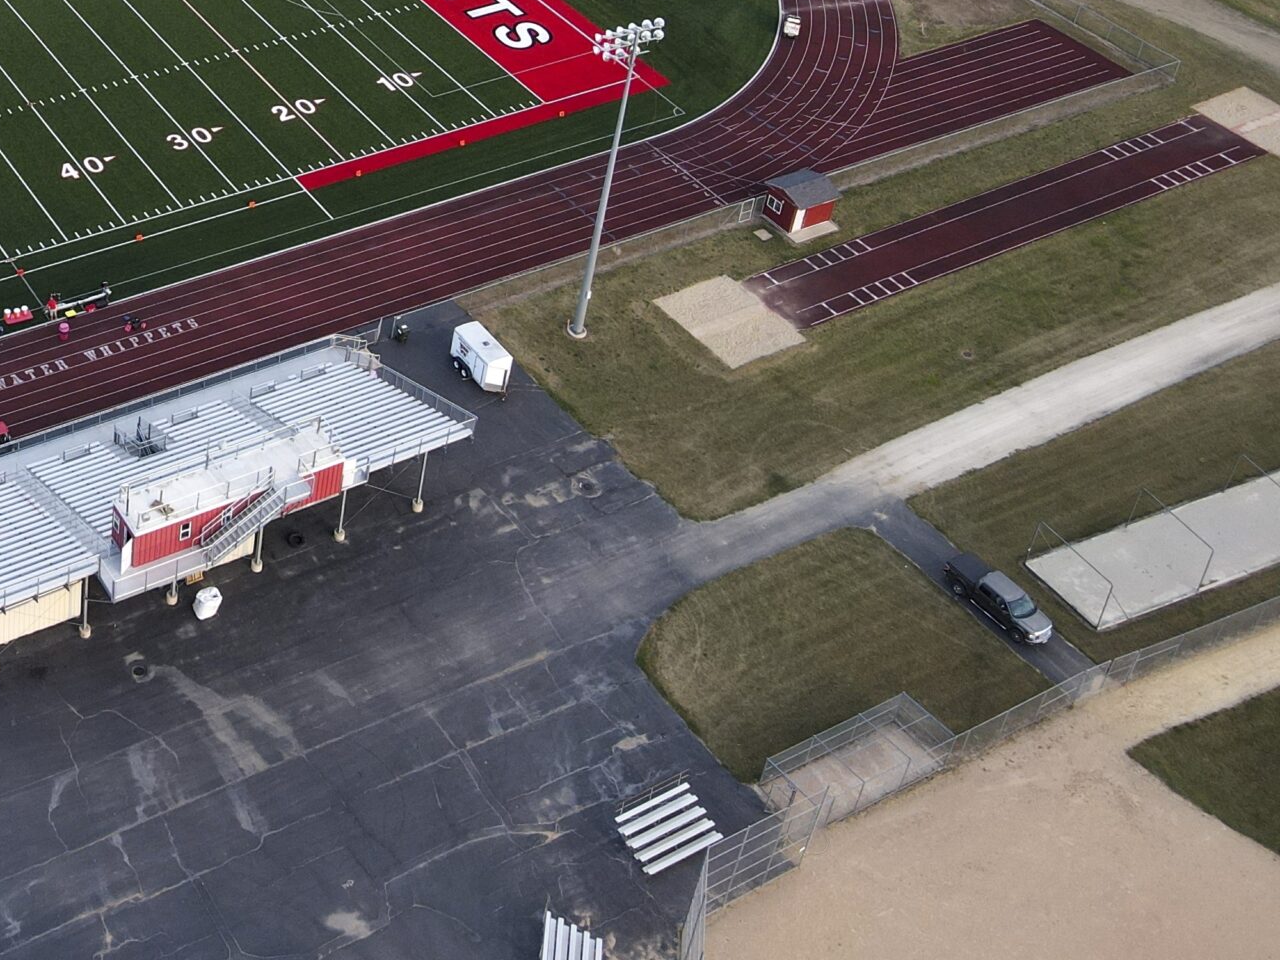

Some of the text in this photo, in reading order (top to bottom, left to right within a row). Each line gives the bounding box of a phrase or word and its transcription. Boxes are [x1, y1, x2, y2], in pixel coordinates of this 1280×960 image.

[377, 72, 415, 92] 10
[271, 98, 317, 123] 20
[166, 126, 213, 151] 30
[60, 155, 105, 180] 40
[83, 318, 200, 363] WHIPPETS
